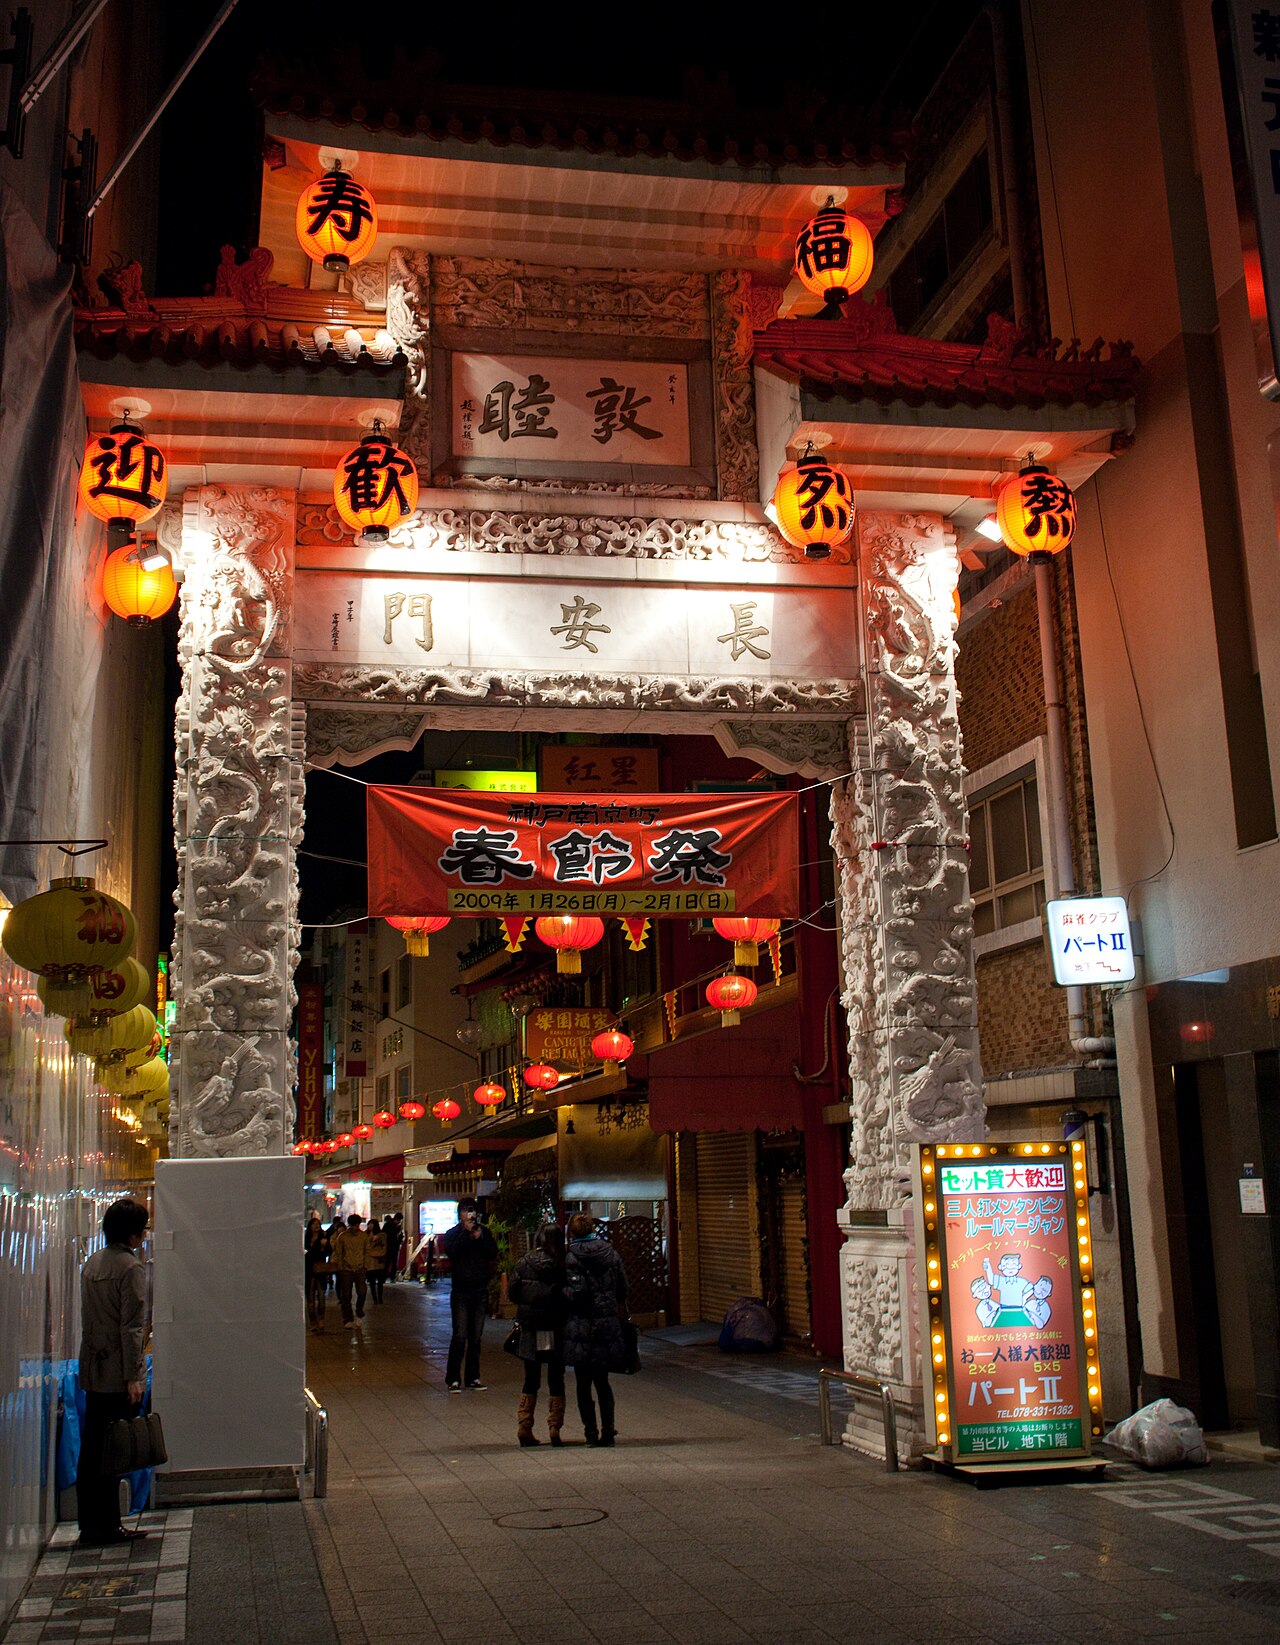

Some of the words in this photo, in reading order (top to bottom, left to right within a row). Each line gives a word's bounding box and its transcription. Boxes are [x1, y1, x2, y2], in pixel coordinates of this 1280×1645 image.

[306, 178, 373, 242] 寿
[797, 216, 851, 279] 福
[89, 436, 164, 509] 迎
[796, 467, 853, 533] 烈
[1021, 476, 1075, 540] 熱
[507, 802, 660, 827] 神戸南京町
[437, 826, 732, 887] 春節祭
[453, 891, 520, 911] 2009年
[1062, 911, 1119, 926] 麻雀クラブ
[965, 1215, 1065, 1239] ルールマージャン
[971, 1435, 1010, 1452] 当ビル
[1021, 1432, 1068, 1449] 地下1階
